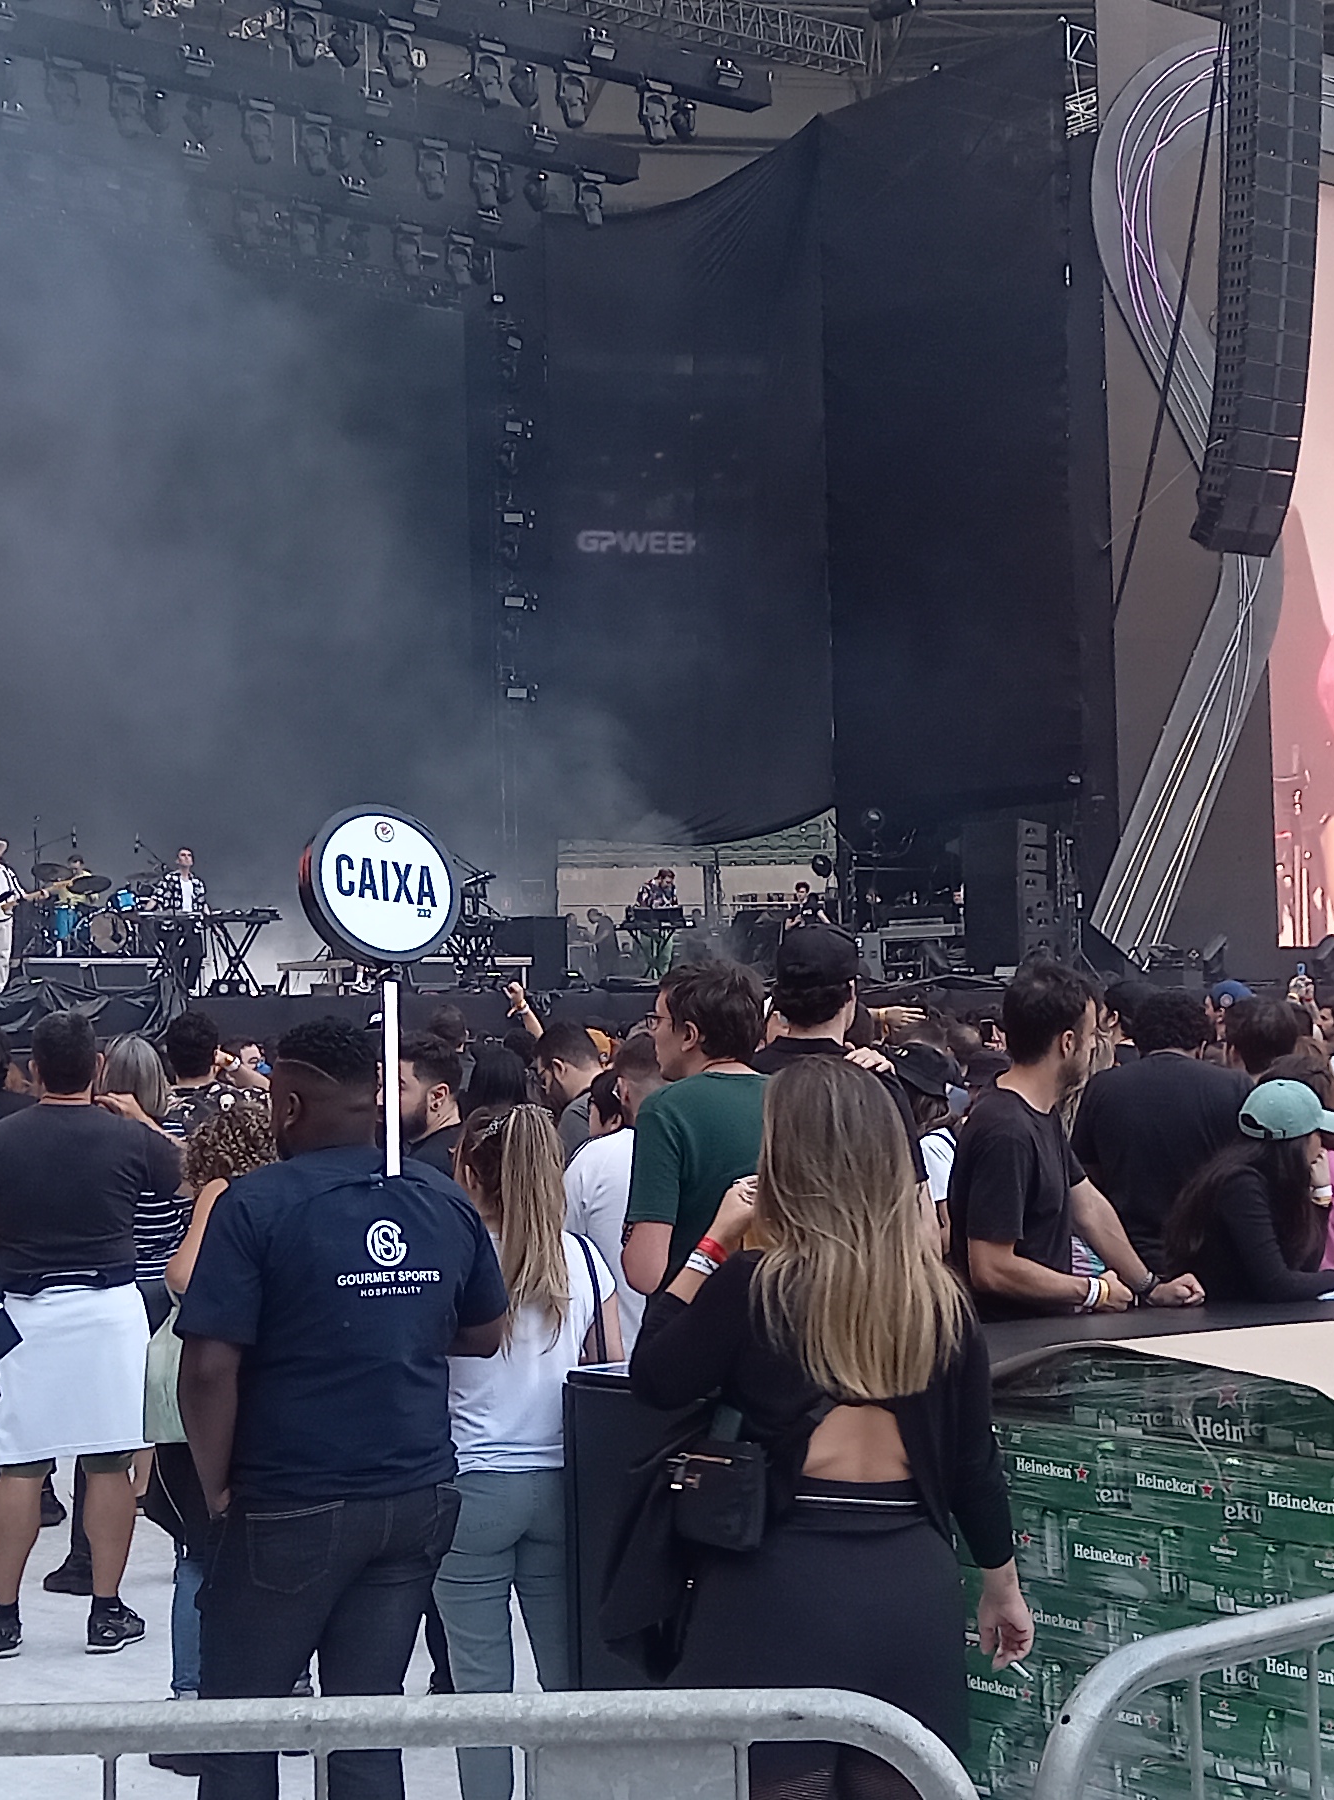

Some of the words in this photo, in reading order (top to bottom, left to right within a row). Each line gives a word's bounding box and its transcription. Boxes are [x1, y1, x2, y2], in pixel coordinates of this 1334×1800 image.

[335, 853, 438, 908] CAIXA
[337, 1271, 396, 1286] GOURMET
[398, 1270, 441, 1282] SPORTS
[360, 1285, 422, 1297] HOSPITALITY
[1016, 1457, 1073, 1480] Heineken
[1136, 1473, 1197, 1495] Heineken
[1074, 1543, 1135, 1567] Heineken
[1029, 1608, 1082, 1632] eineken
